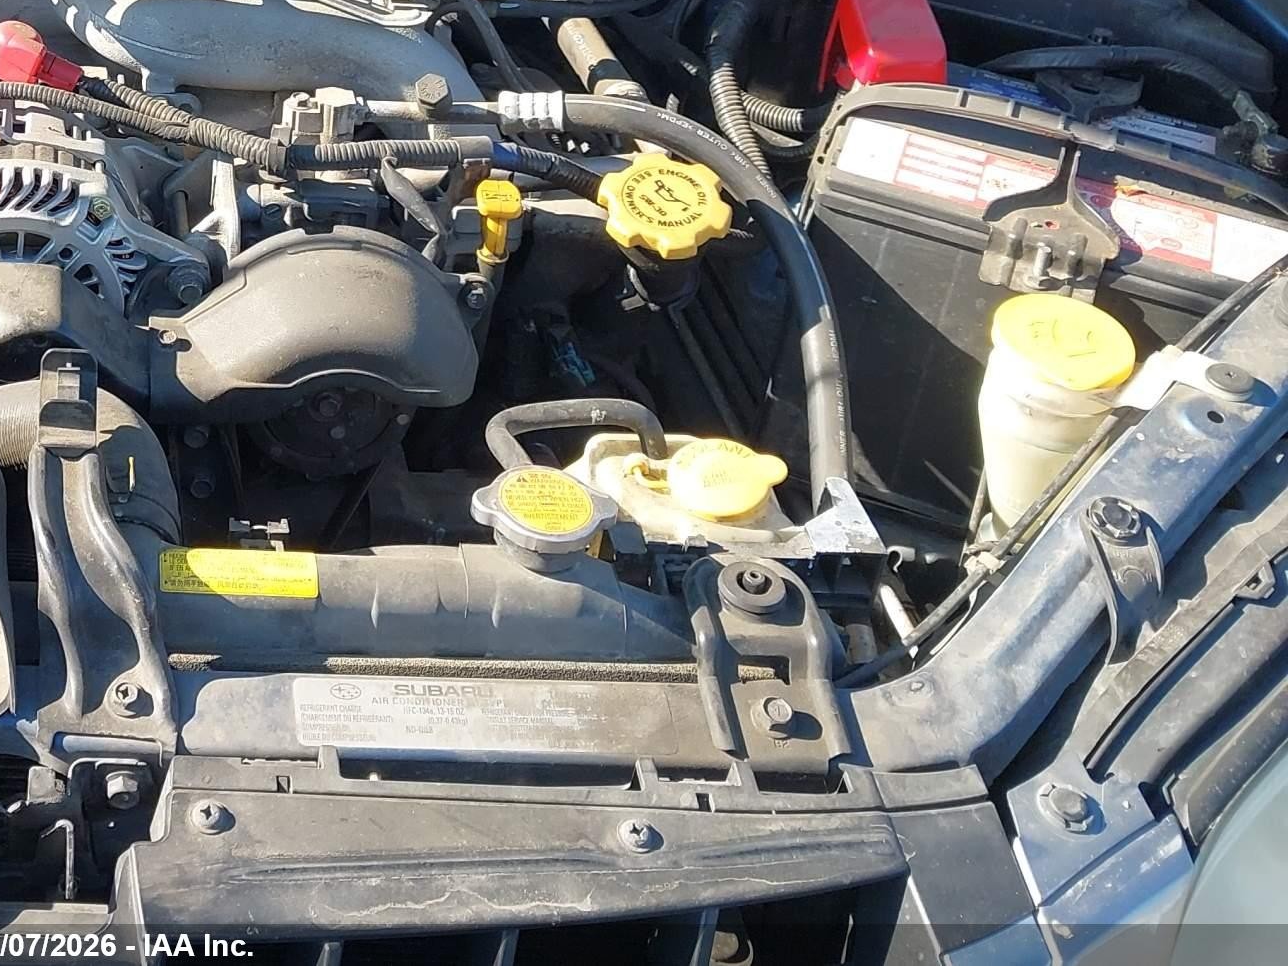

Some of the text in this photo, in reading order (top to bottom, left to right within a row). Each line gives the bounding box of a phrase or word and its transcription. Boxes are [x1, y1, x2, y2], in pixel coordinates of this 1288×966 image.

[696, 129, 728, 151] OUTER
[658, 168, 707, 207] ENGINE OIL
[632, 170, 653, 185] SEE
[657, 212, 703, 228] MANUAL
[371, 697, 389, 706] AIR
[394, 684, 492, 697] SUBARU
